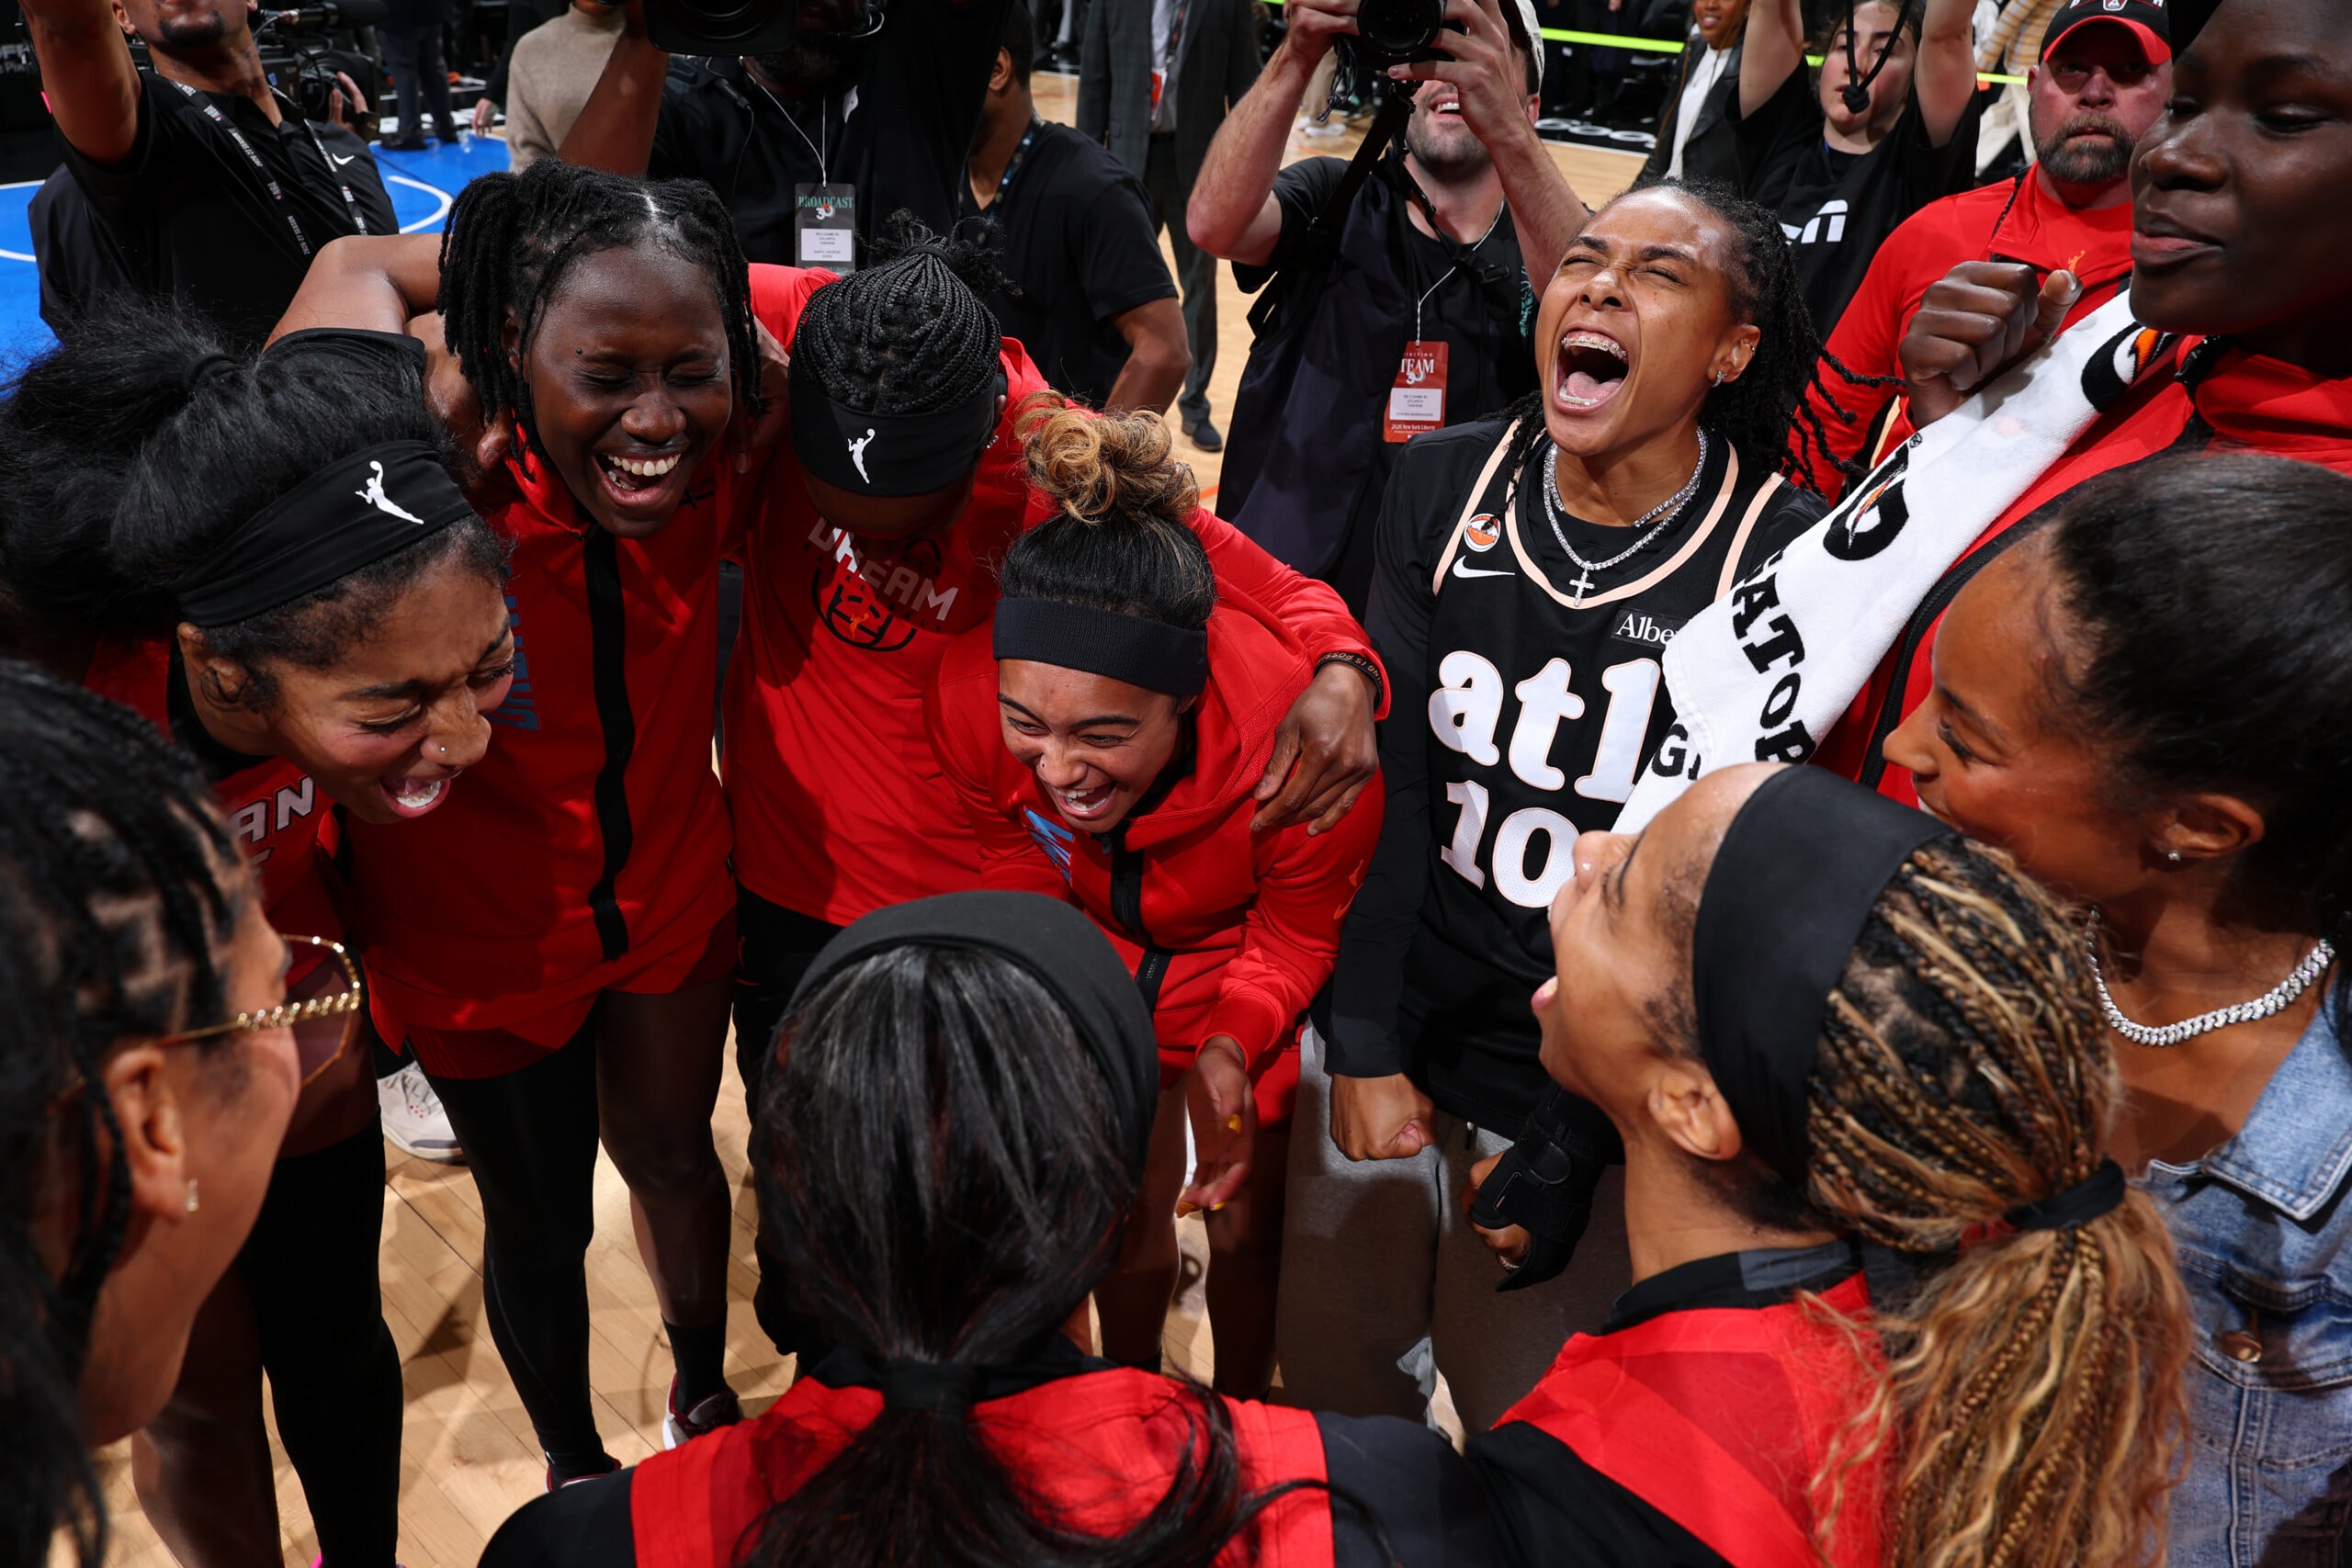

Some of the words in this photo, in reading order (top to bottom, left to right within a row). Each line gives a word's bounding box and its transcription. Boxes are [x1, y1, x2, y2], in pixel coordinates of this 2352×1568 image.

[798, 196, 854, 209] BROADCAST
[1401, 358, 1434, 374] TEAM
[1615, 613, 1679, 644] Albe
[1428, 650, 1661, 803] atl
[1441, 780, 1580, 908] 10
